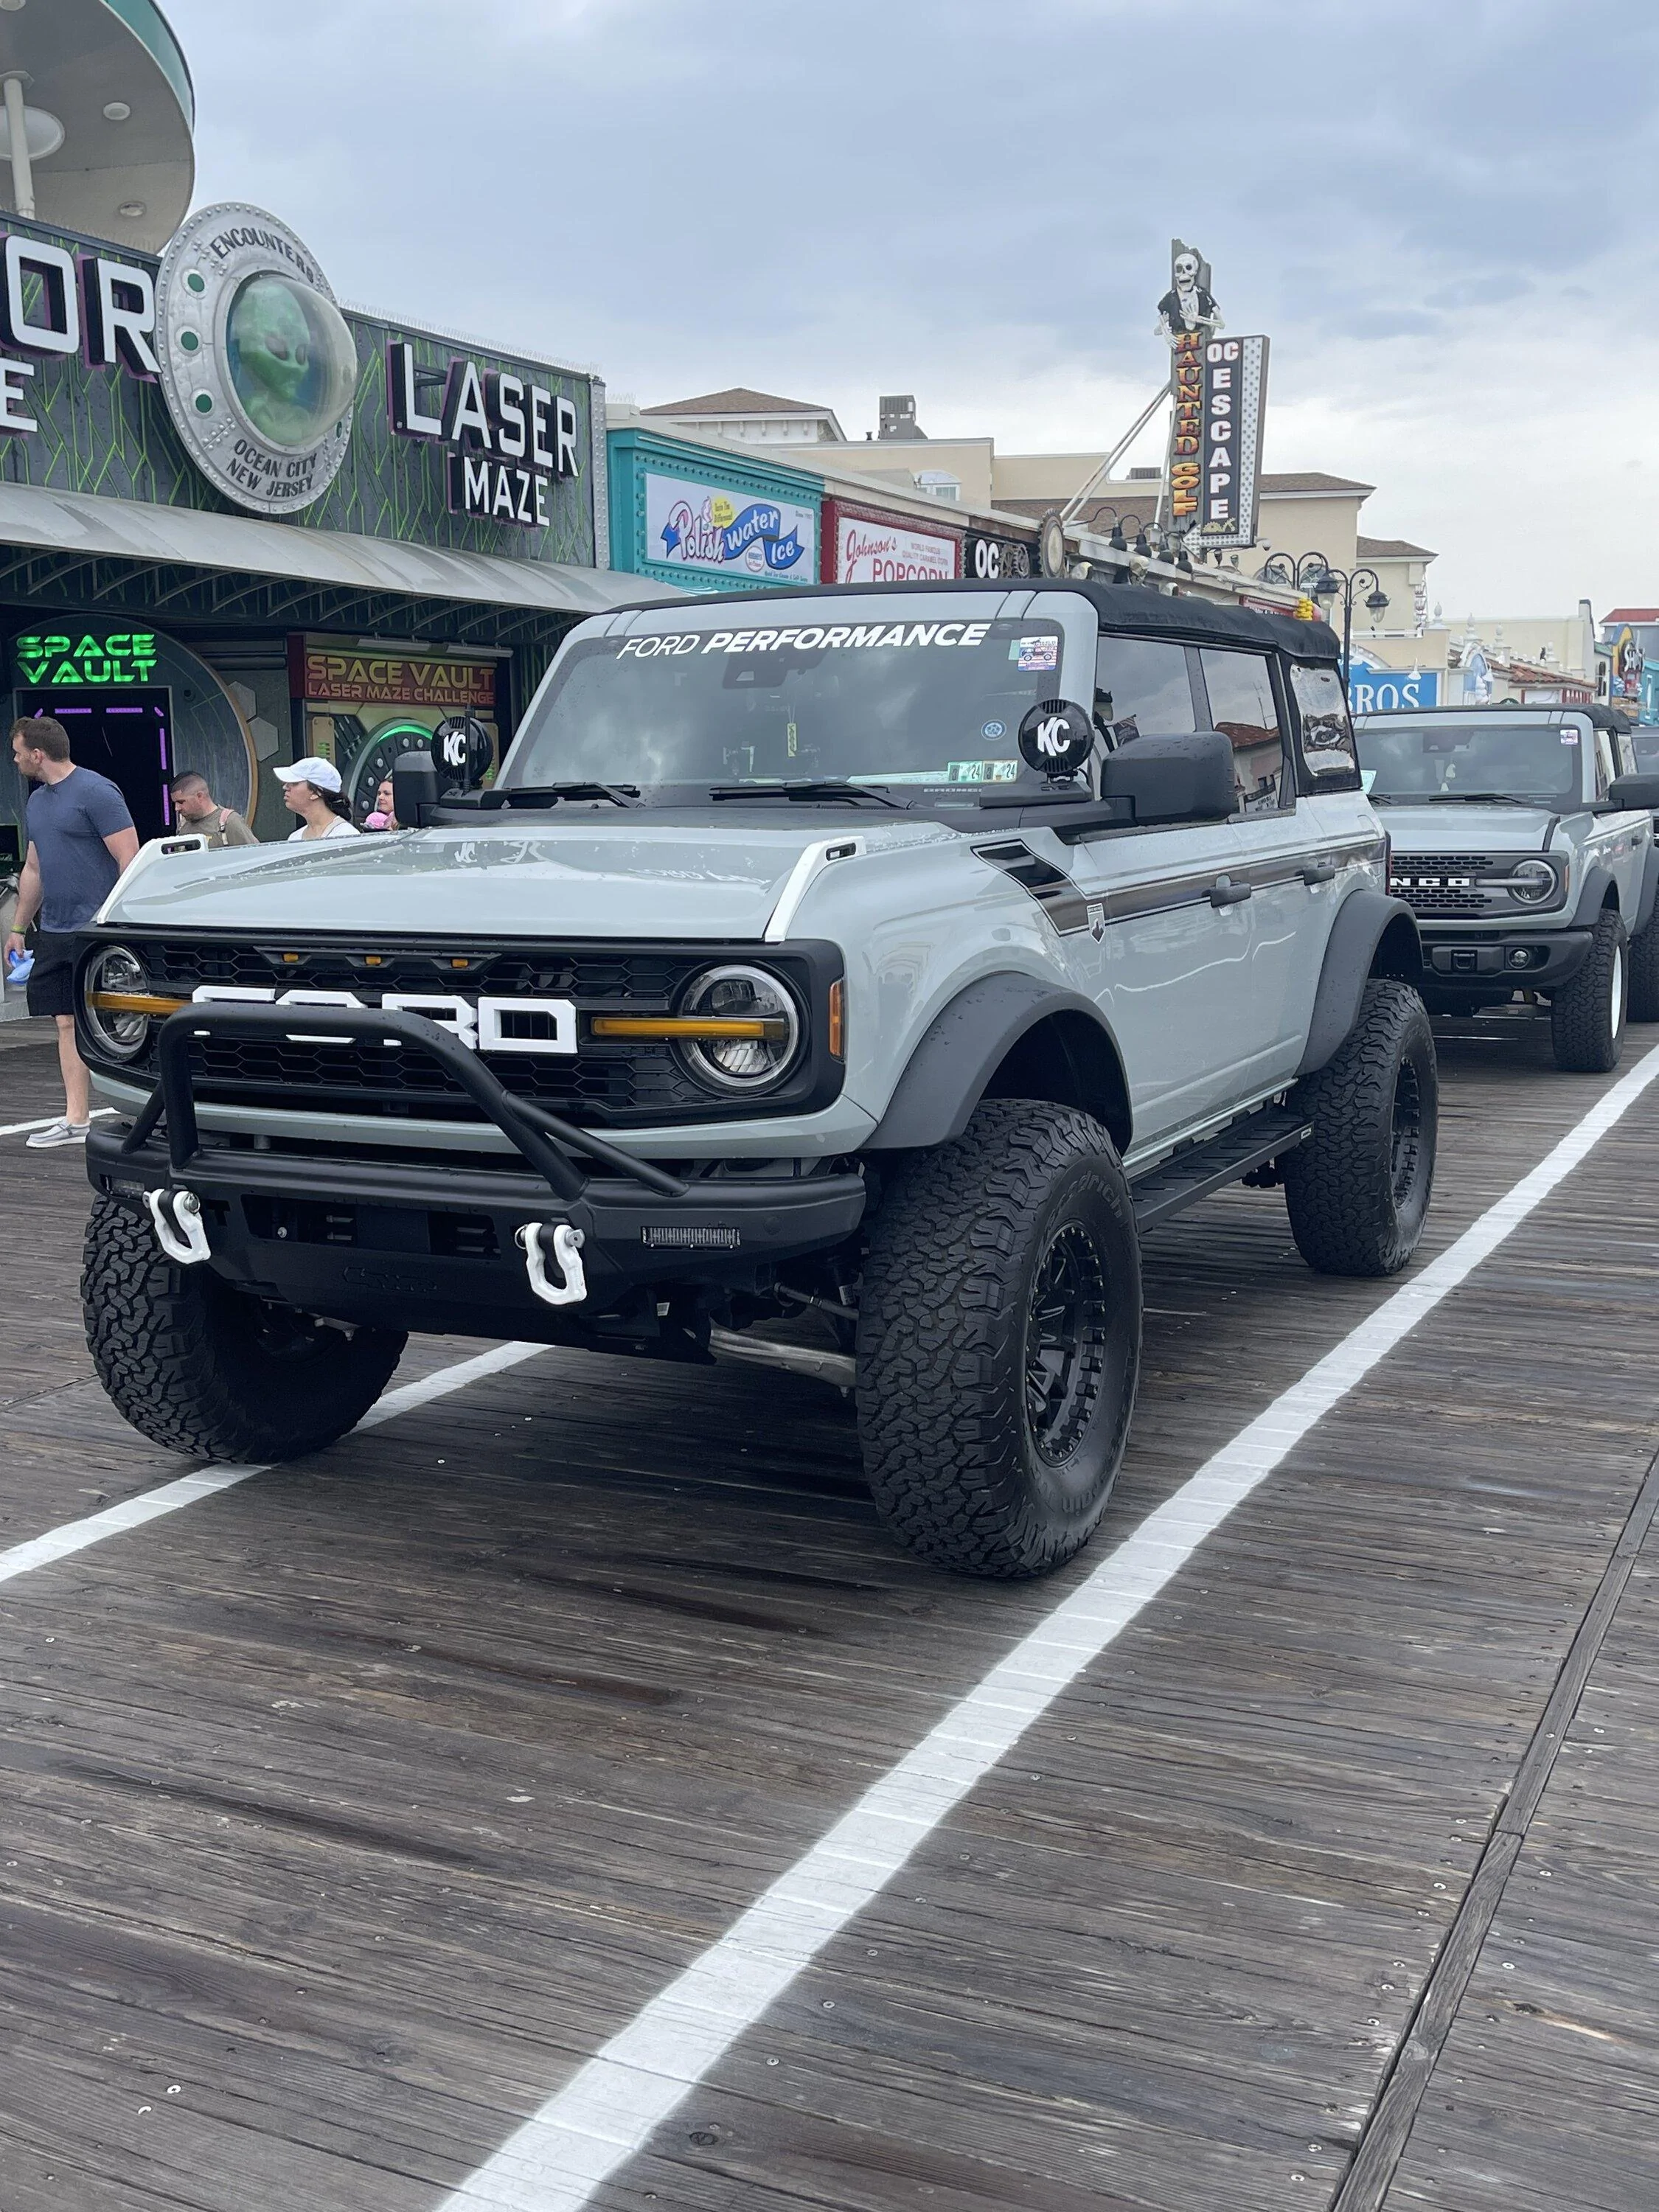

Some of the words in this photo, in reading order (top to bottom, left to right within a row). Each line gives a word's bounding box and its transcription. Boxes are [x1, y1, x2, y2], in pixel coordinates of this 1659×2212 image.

[4, 234, 162, 373] OR
[1206, 341, 1239, 363] OC
[0, 357, 38, 433] E
[403, 343, 579, 478] LASER
[1174, 332, 1202, 456] HAUNTED
[234, 439, 281, 478] OCEAN
[286, 453, 317, 478] CITY
[1208, 367, 1232, 519] ESCAPE
[226, 458, 262, 490] NEW
[266, 474, 313, 497] JERSEY
[464, 456, 550, 527] MAZE
[1170, 461, 1200, 517] GOLF
[668, 501, 726, 564] Polish
[726, 509, 779, 551] water
[771, 540, 795, 565] Ice
[844, 529, 898, 583] Johnson's
[975, 539, 1000, 579] OC
[16, 634, 156, 658] SPACE
[616, 634, 701, 660] FORD
[700, 623, 992, 655] PERFORMANCE
[17, 659, 157, 684] VAULT
[307, 655, 403, 685] SPACE
[408, 663, 494, 690] VAULT
[307, 683, 363, 698] LASER
[366, 686, 411, 700] MAZE
[414, 688, 494, 704] CHALLENGE
[443, 731, 467, 766] KC
[1037, 717, 1071, 757] KC
[971, 763, 981, 779] 24
[1006, 763, 1016, 779] 24
[1390, 877, 1470, 886] NCO
